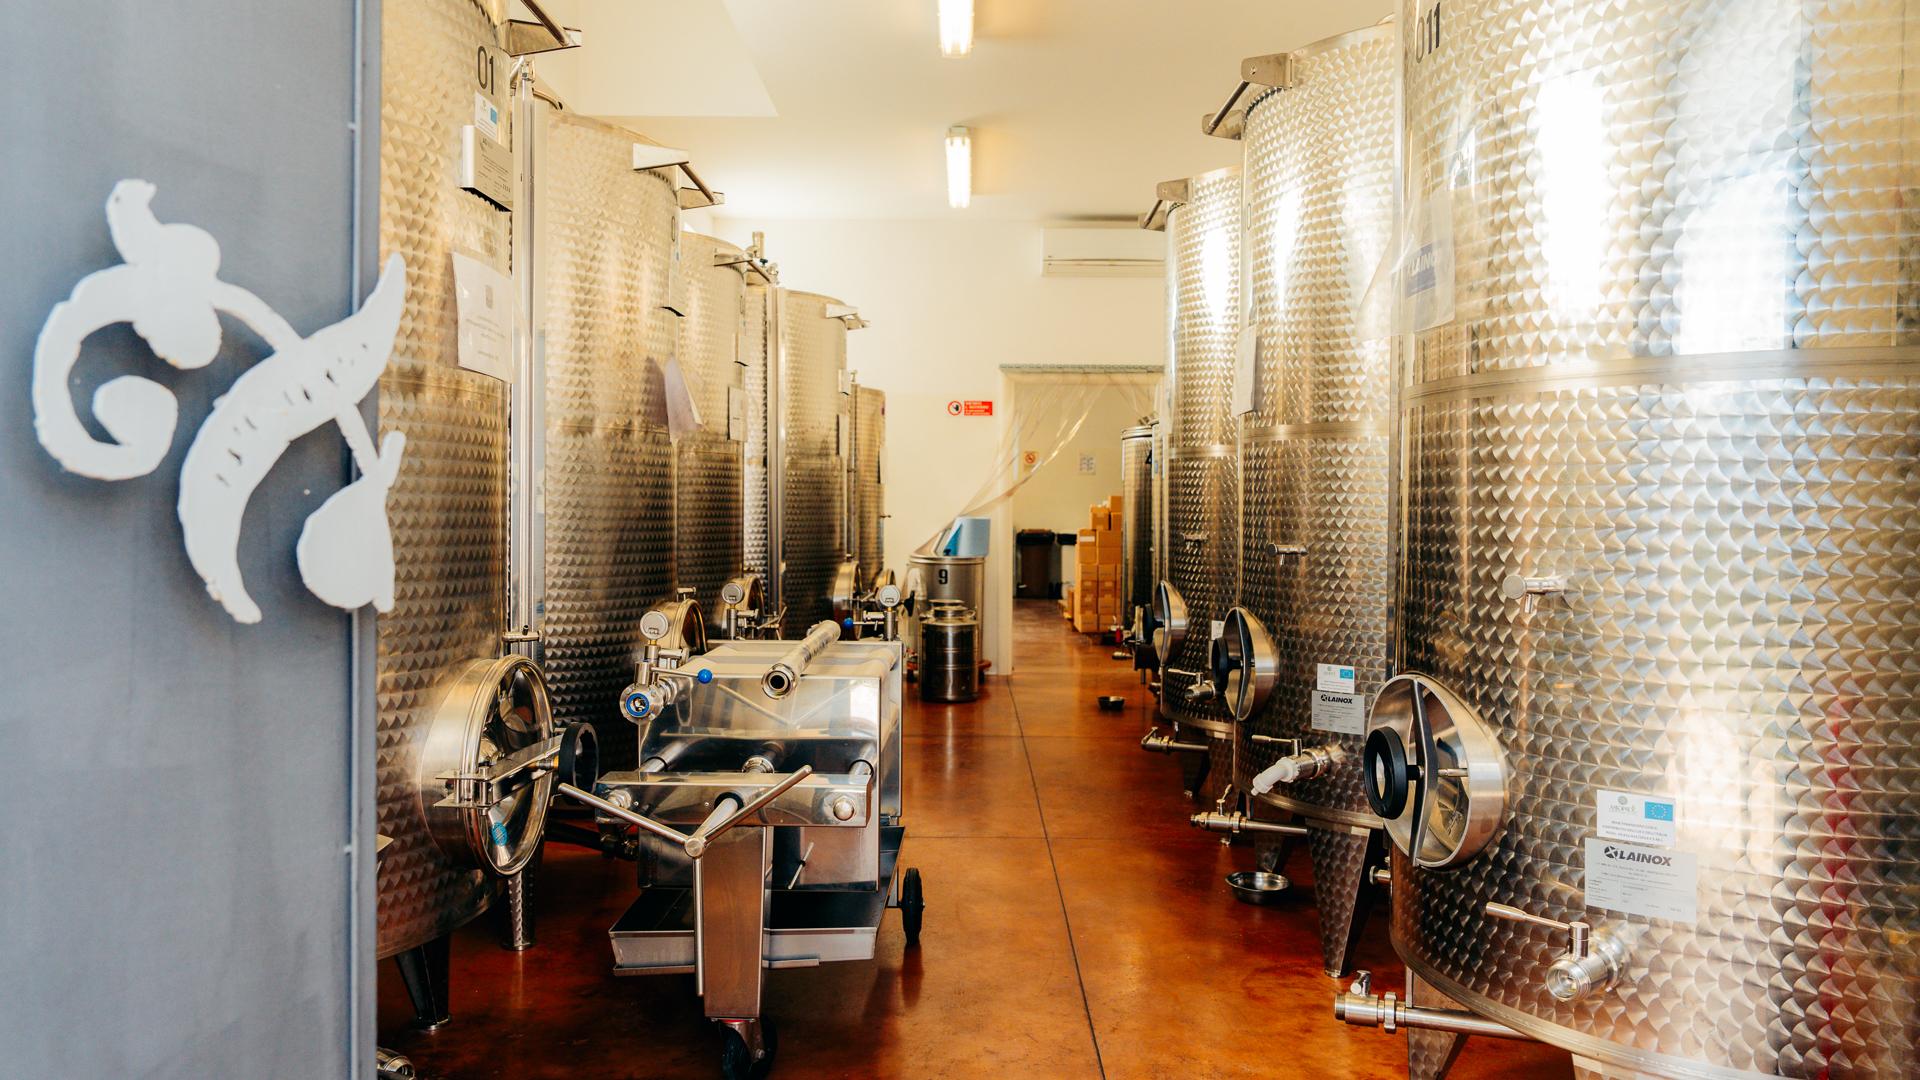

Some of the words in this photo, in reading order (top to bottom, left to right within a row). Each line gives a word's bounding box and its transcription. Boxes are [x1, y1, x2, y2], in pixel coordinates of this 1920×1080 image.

[1416, 2, 1440, 63] 011
[477, 45, 494, 95] 01
[938, 569, 948, 584] 9
[1328, 696, 1353, 705] LAINOX
[1619, 850, 1672, 867] LAINOX
